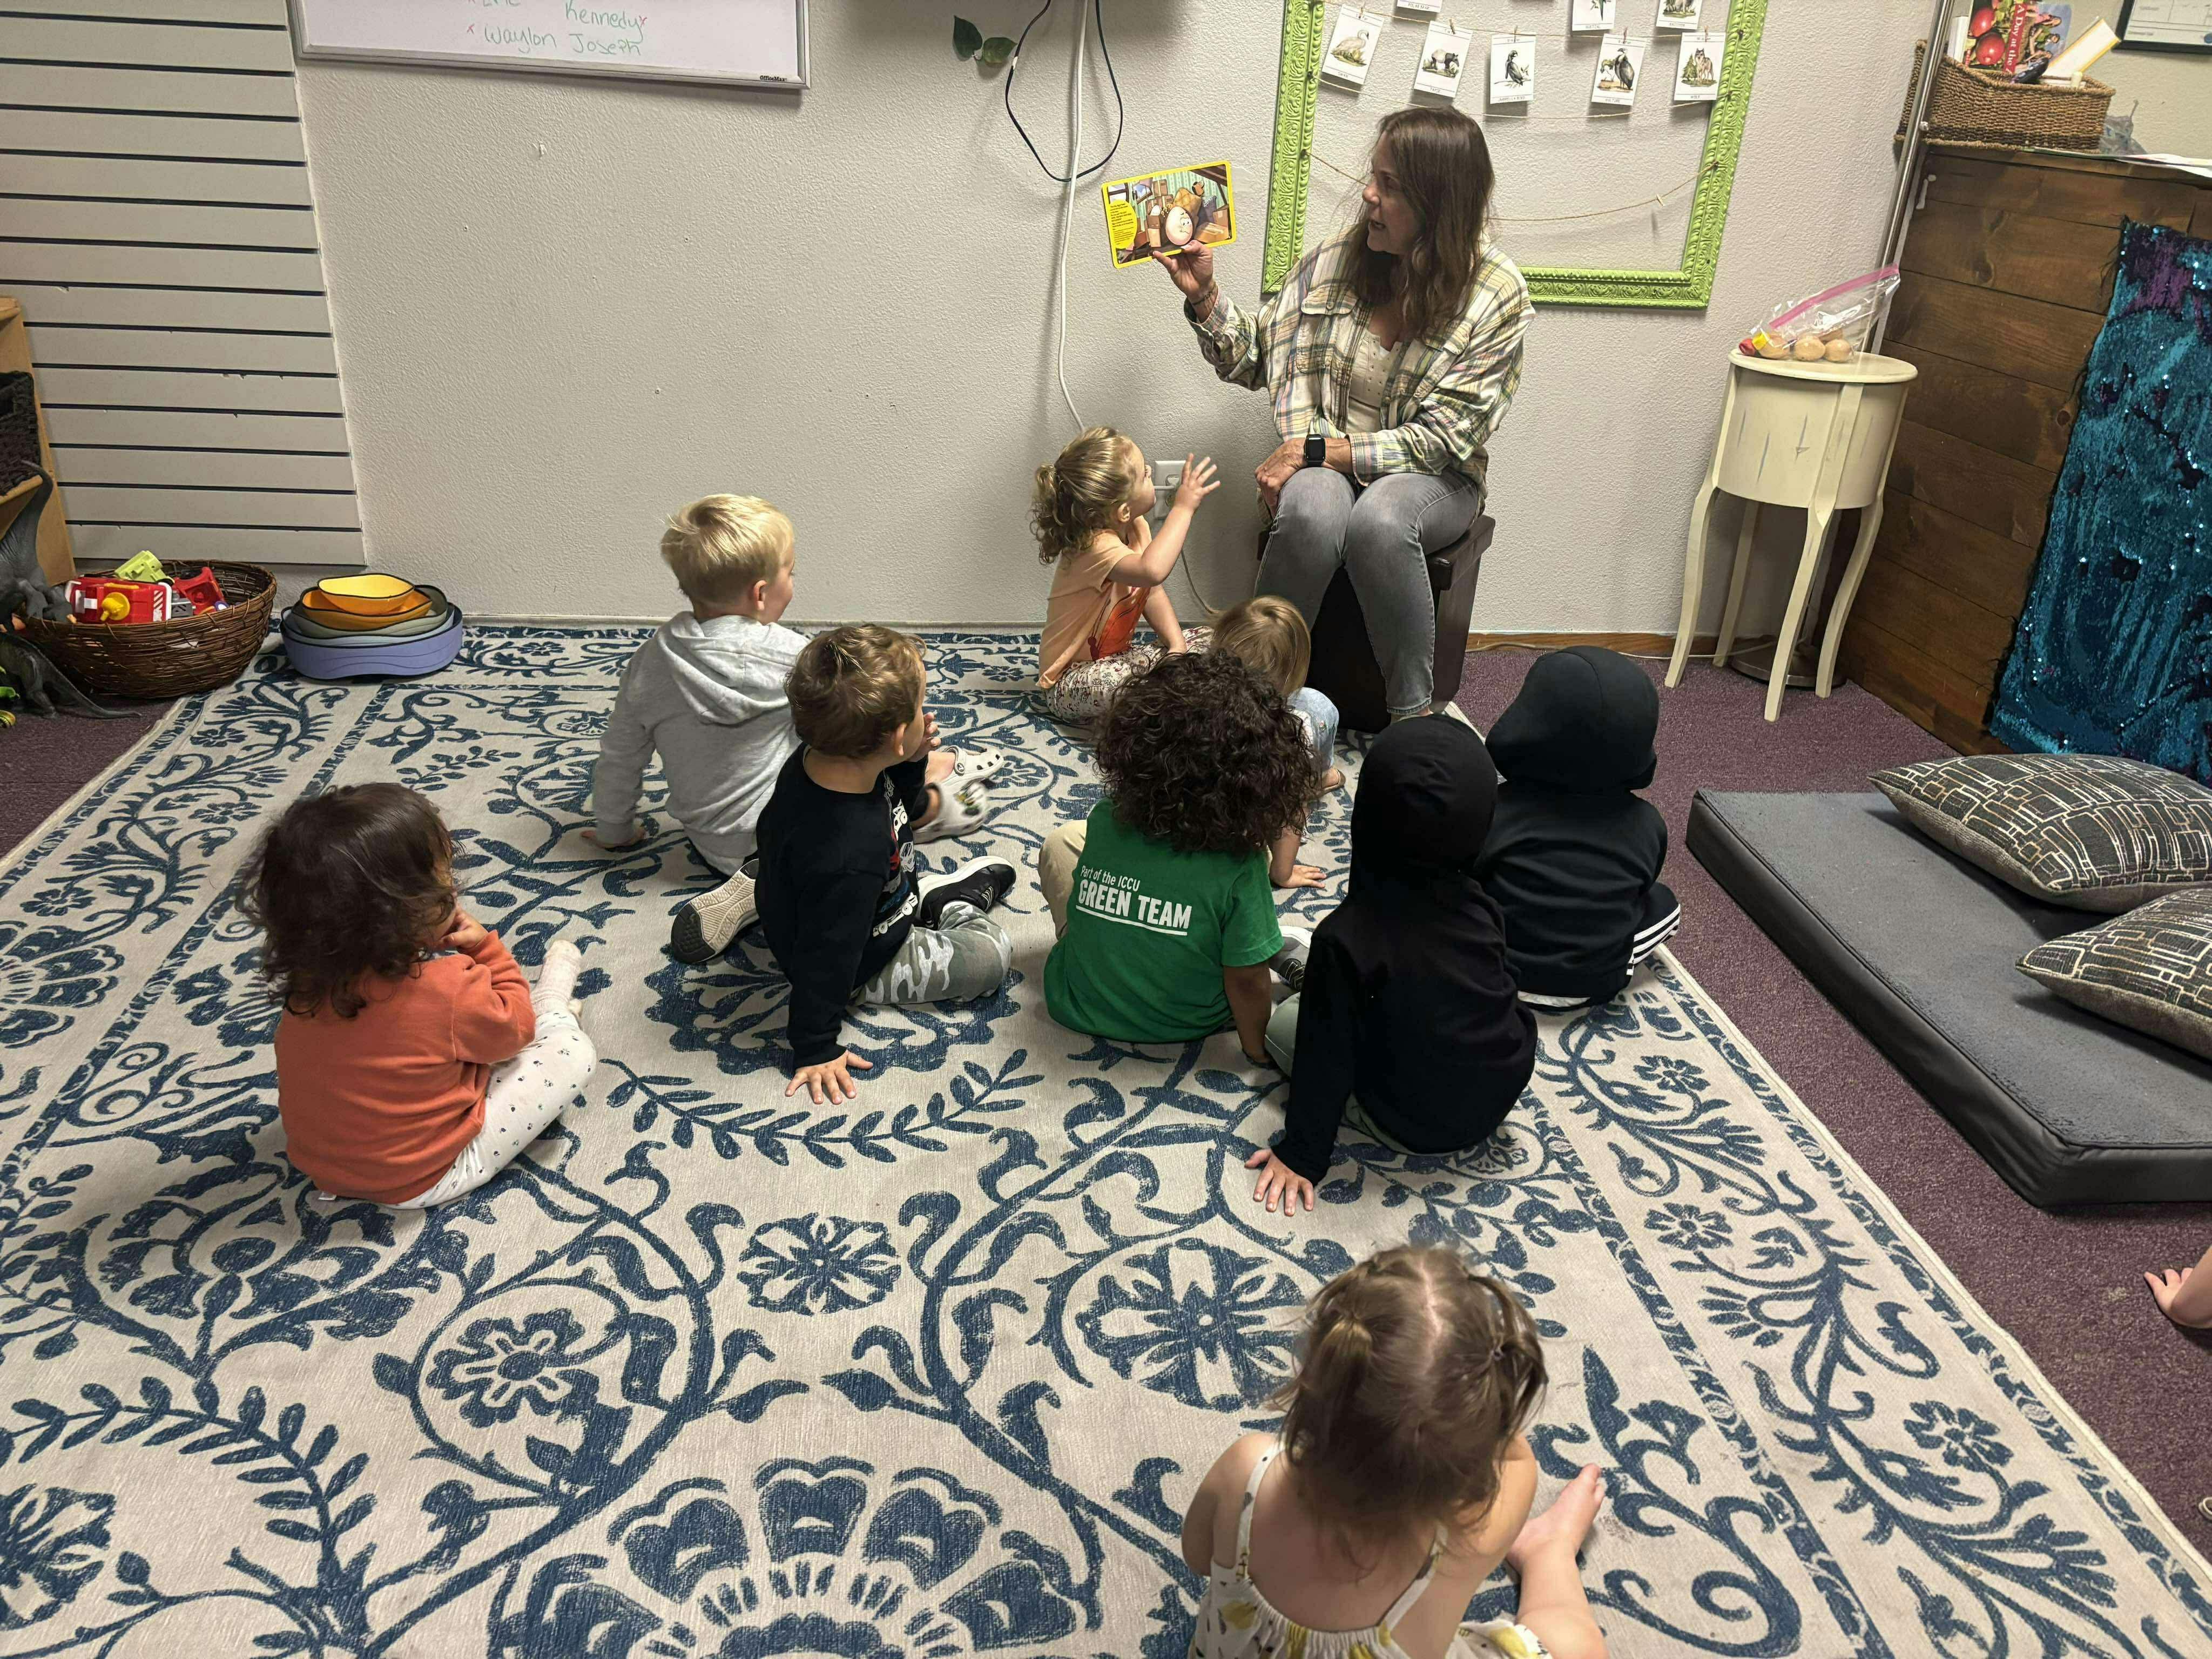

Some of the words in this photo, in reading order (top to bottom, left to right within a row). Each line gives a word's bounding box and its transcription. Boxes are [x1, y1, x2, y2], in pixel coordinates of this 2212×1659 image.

[484, 26, 557, 53] Waylon
[566, 1, 644, 44] Kennedy
[1081, 865, 1094, 879] Part
[1093, 869, 1102, 881] of
[1102, 871, 1116, 886] the
[1117, 875, 1141, 892] ICCU
[1078, 879, 1132, 917] GREEN
[1138, 895, 1192, 929] TEAM
